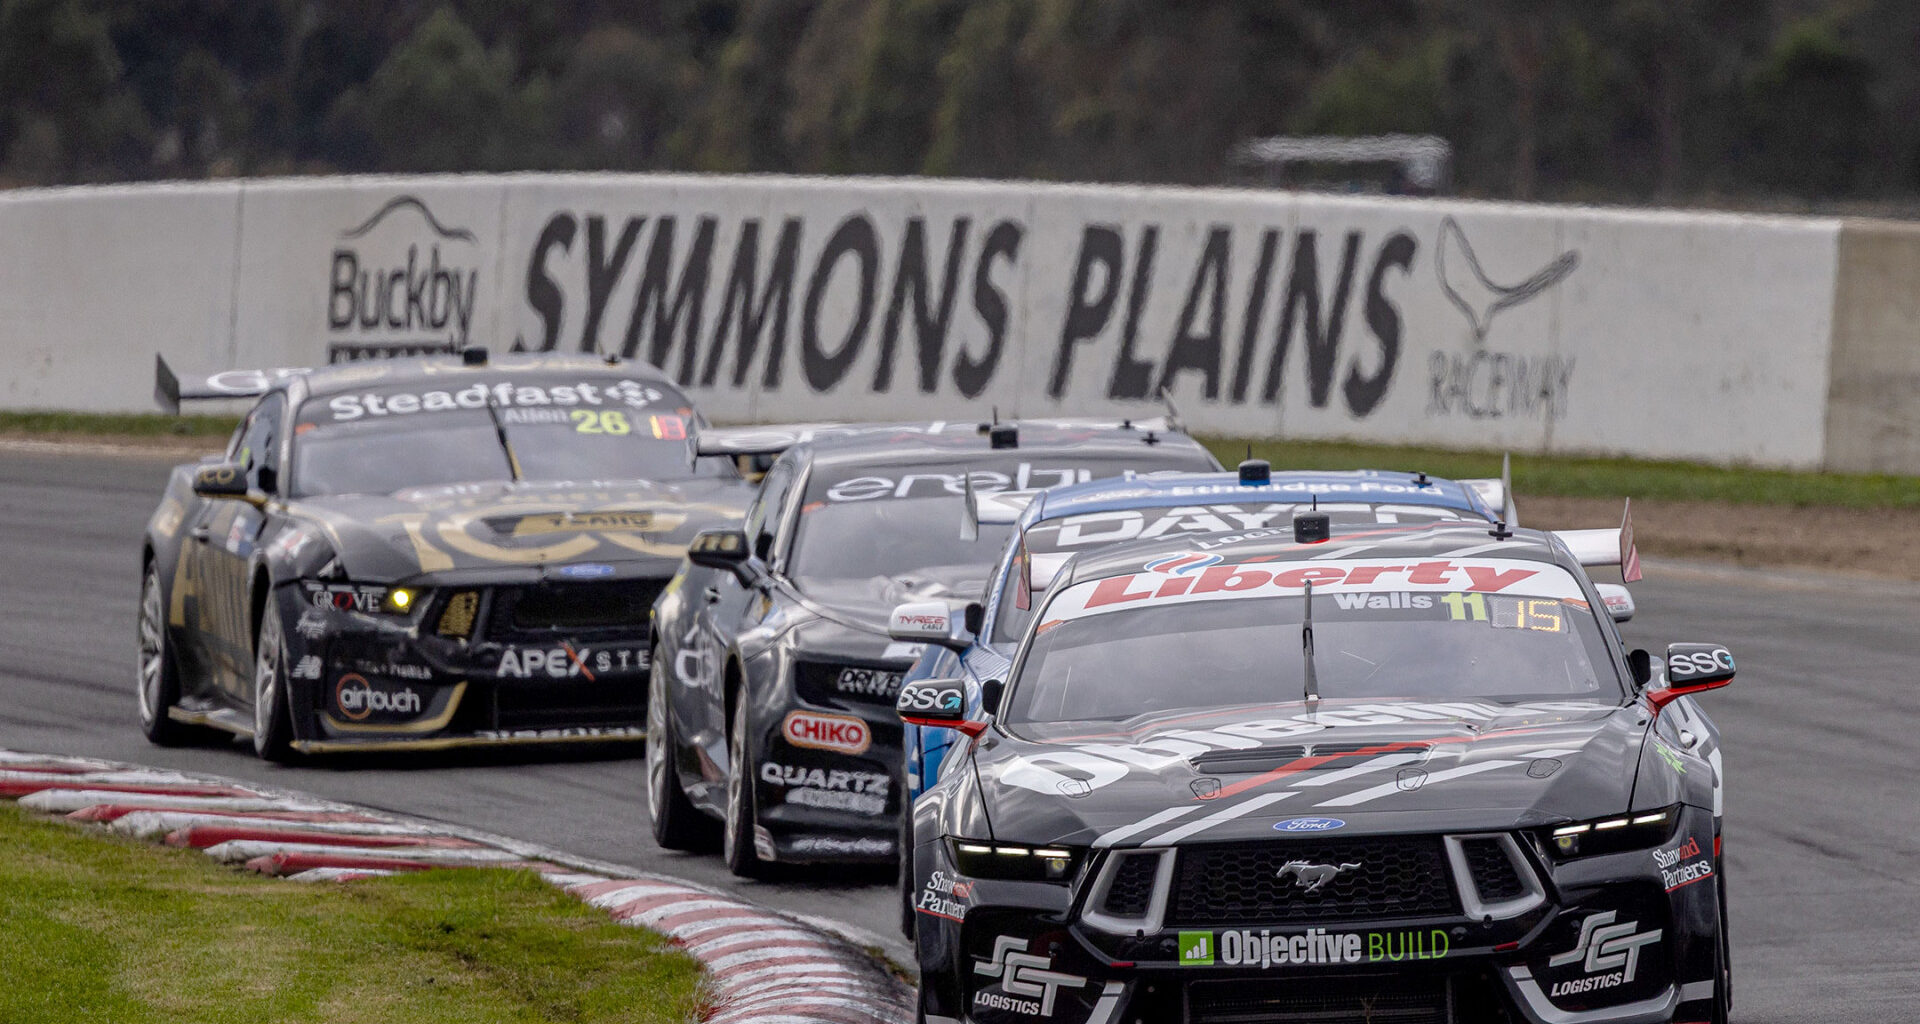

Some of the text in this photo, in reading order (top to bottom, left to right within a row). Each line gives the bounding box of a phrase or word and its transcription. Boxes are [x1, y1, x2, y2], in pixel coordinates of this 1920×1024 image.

[328, 243, 477, 350] Buckby
[510, 210, 1418, 416] SYMMONS PLAINS
[1426, 350, 1576, 418] RACEWAY
[329, 381, 603, 420] Steadfast
[570, 409, 630, 434] 26
[1055, 503, 1461, 547] DAY
[1083, 561, 1540, 610] Liberty
[312, 591, 382, 612] GROVE
[1334, 592, 1489, 621] Walls 11
[899, 616, 946, 624] TYREE
[496, 640, 596, 682] APEX
[595, 650, 650, 672] STE
[339, 685, 421, 712] airtouch
[789, 718, 863, 747] CHIKO
[761, 761, 890, 796] QUARTZ
[1287, 818, 1332, 830] Ford
[1661, 860, 1712, 890] Partners
[917, 889, 966, 920] Partners
[1221, 928, 1449, 969] Objective BUILD
[1551, 972, 1622, 997] LOGISTICS
[974, 990, 1040, 1016] LOGISTICS
